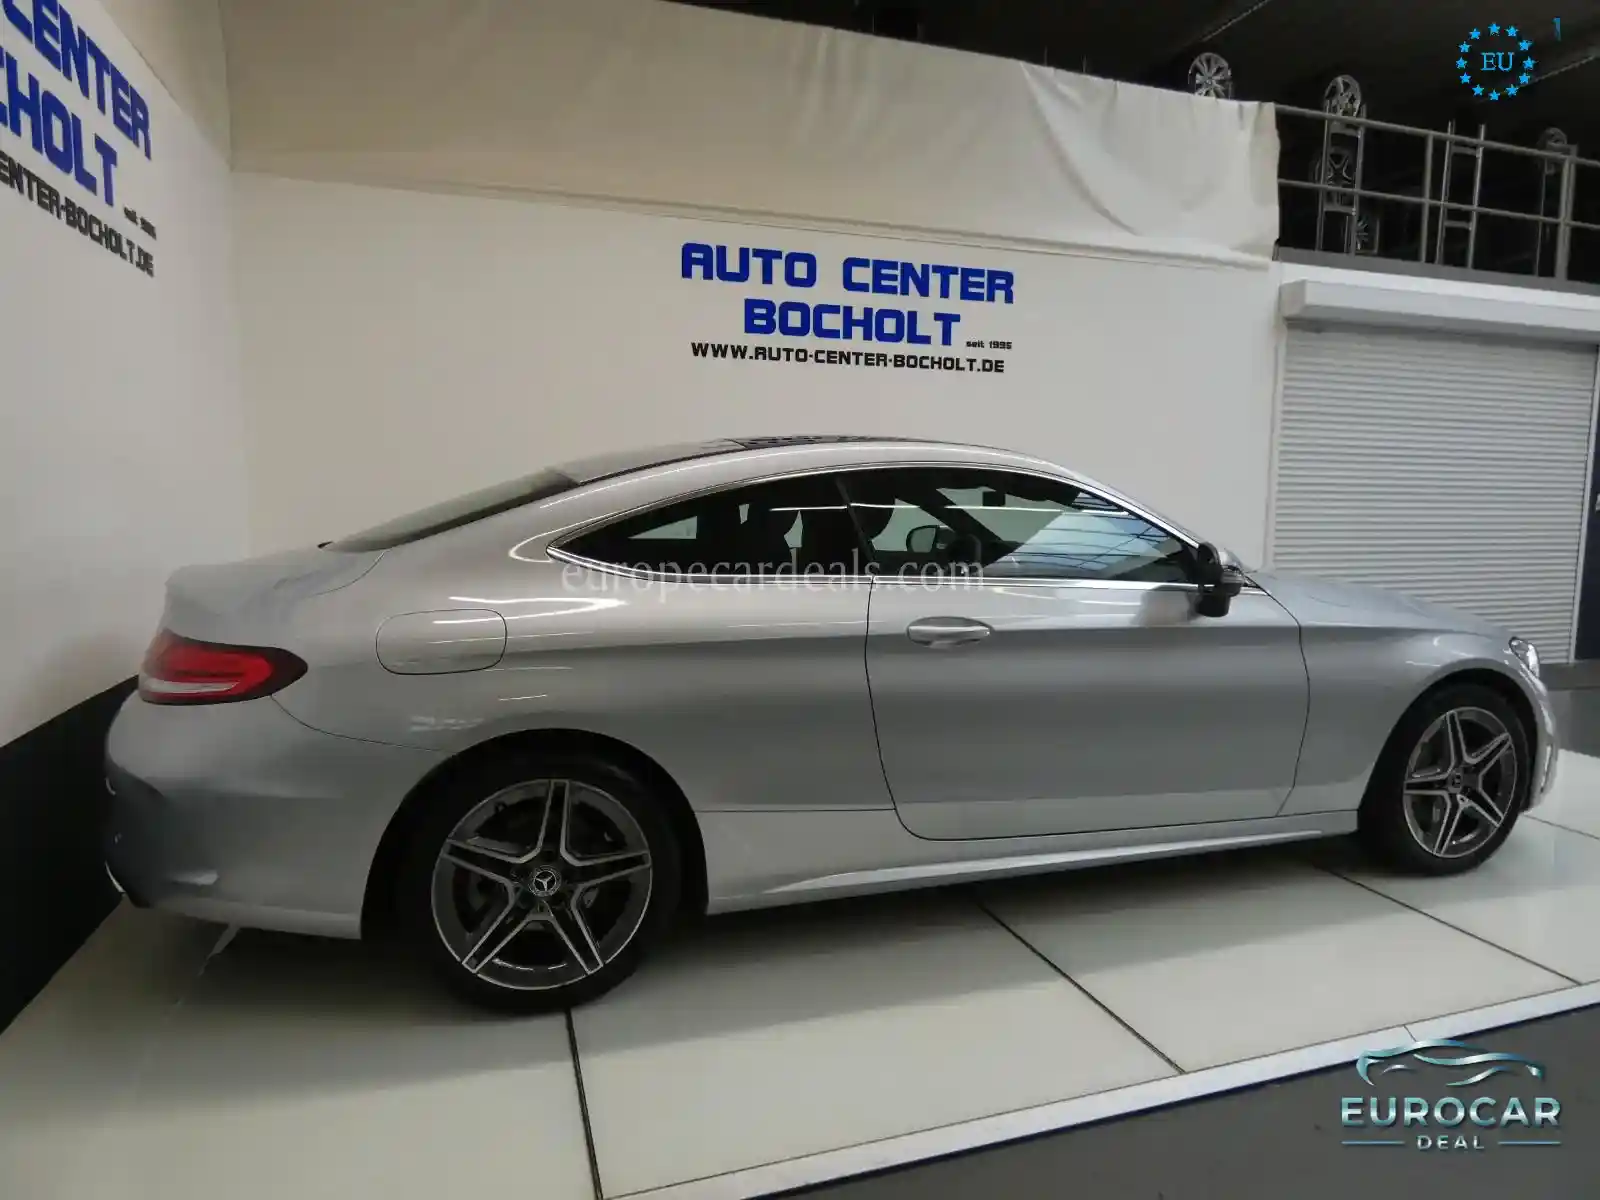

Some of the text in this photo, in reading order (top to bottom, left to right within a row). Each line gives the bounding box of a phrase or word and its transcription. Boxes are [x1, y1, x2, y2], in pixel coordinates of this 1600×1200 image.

[0, 45, 117, 207] HOLT
[681, 242, 1014, 304] AUTO CENTER
[744, 298, 961, 346] BOCHOLT
